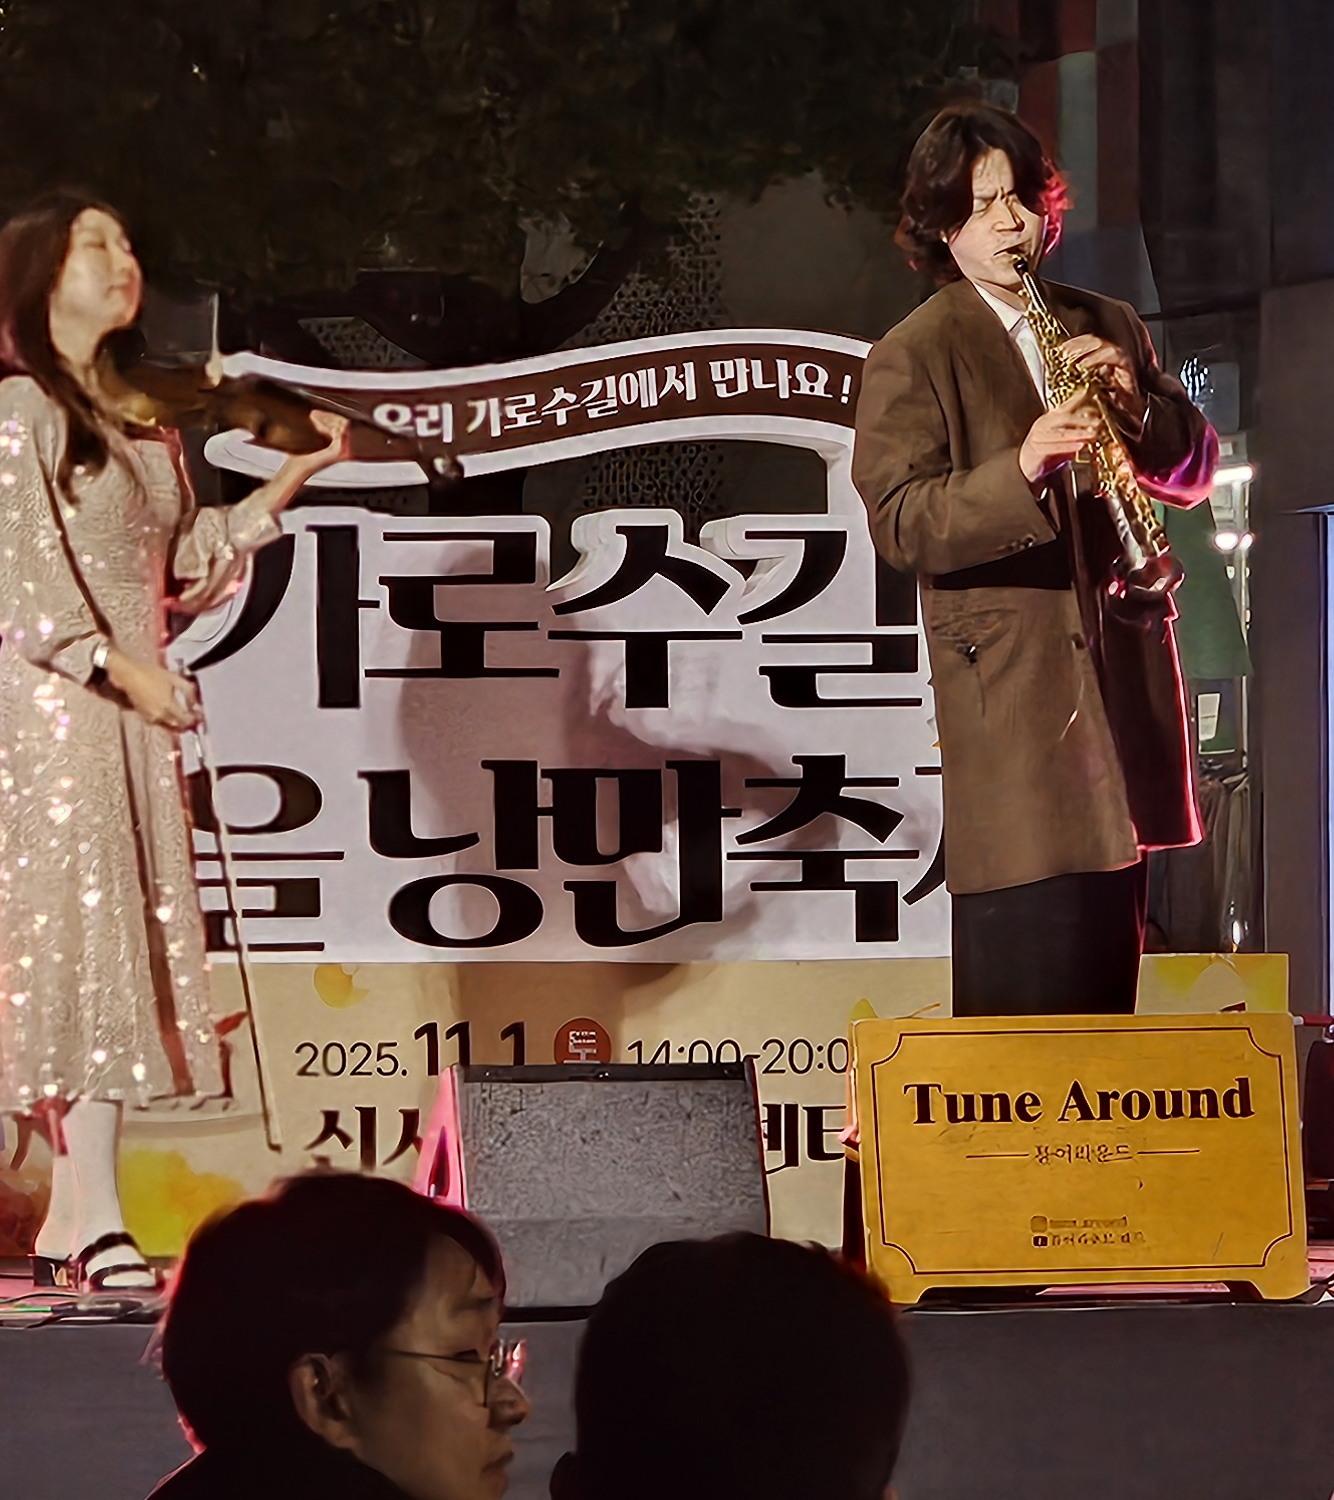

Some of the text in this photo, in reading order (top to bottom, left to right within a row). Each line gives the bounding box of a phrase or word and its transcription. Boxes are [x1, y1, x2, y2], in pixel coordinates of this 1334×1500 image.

[466, 361, 697, 438] 가로수길에서
[187, 520, 924, 710] 가로수길
[903, 1076, 1256, 1125] Tune Around
